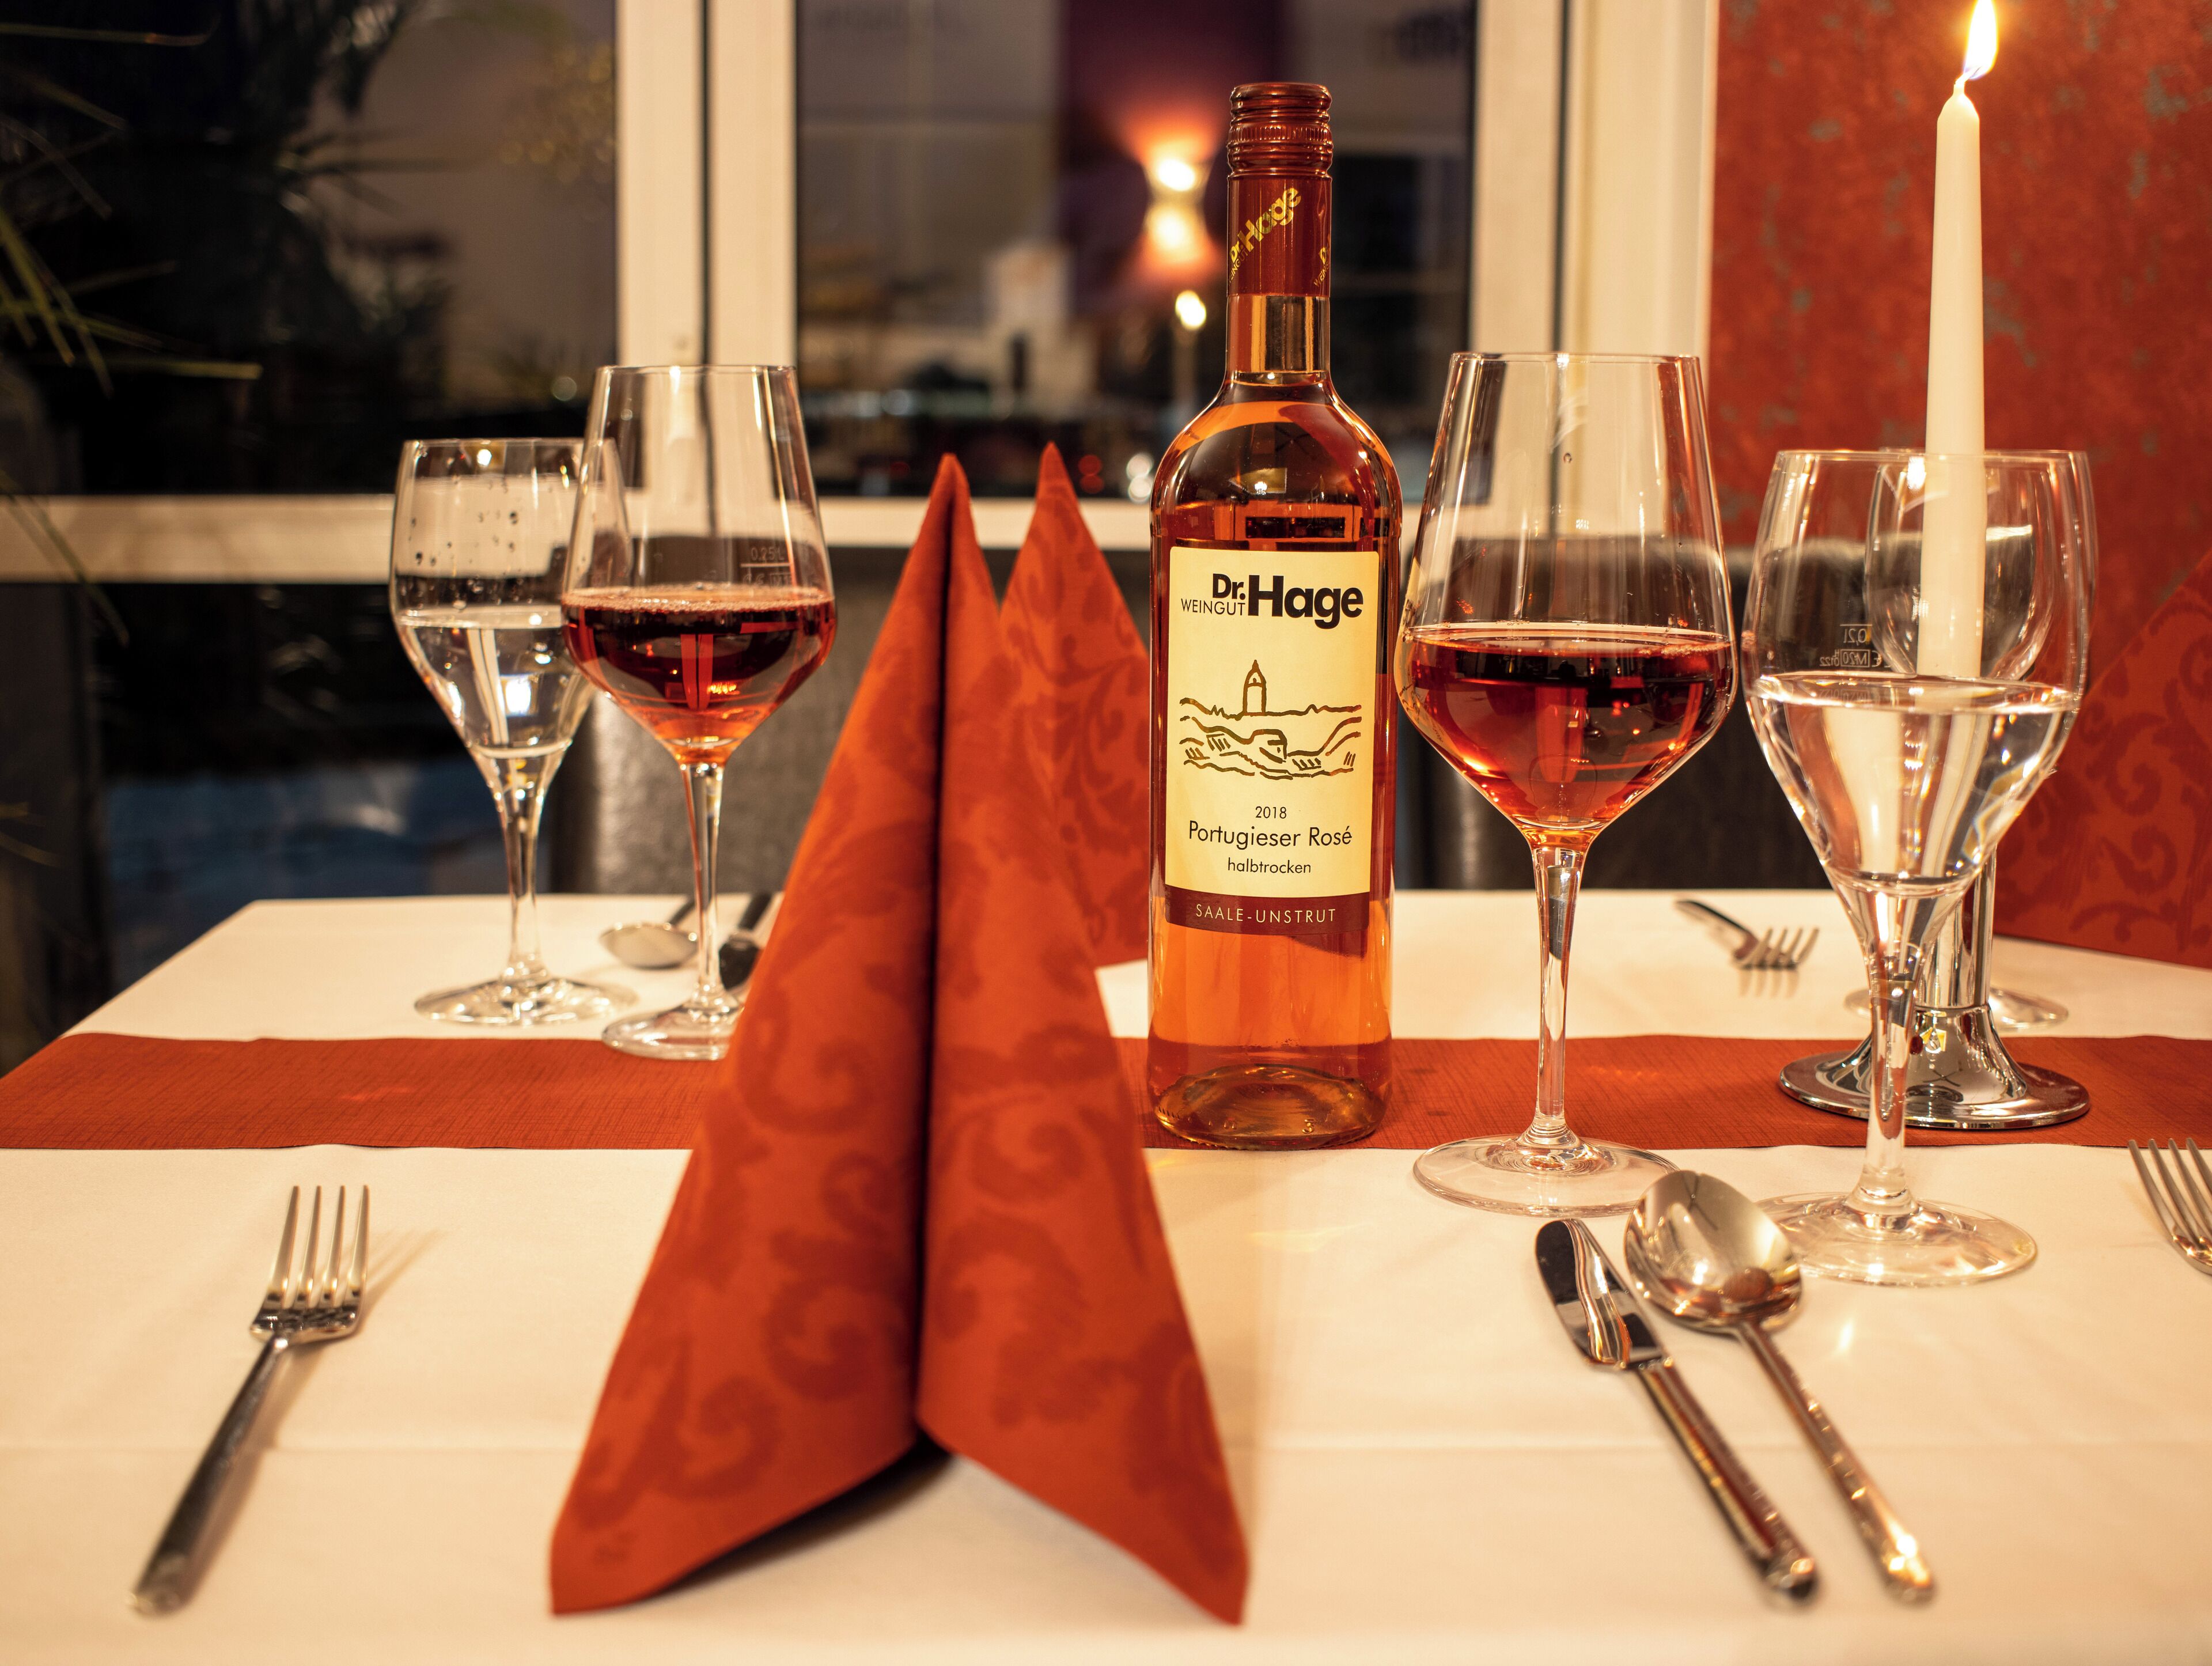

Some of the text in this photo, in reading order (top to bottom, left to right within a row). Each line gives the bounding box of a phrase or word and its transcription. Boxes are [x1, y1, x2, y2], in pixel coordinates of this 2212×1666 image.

[1237, 187, 1301, 253] Hage
[1229, 249, 1249, 283] EINGUT
[1181, 597, 1245, 616] WEINGUT
[1212, 573, 1364, 630] Dr. Hage
[1255, 805, 1287, 819] 2018
[1189, 820, 1353, 850] Portugieser Rosé
[1228, 857, 1312, 874] halbtrocken
[1195, 903, 1336, 924] SAALE-UNSTRUT
